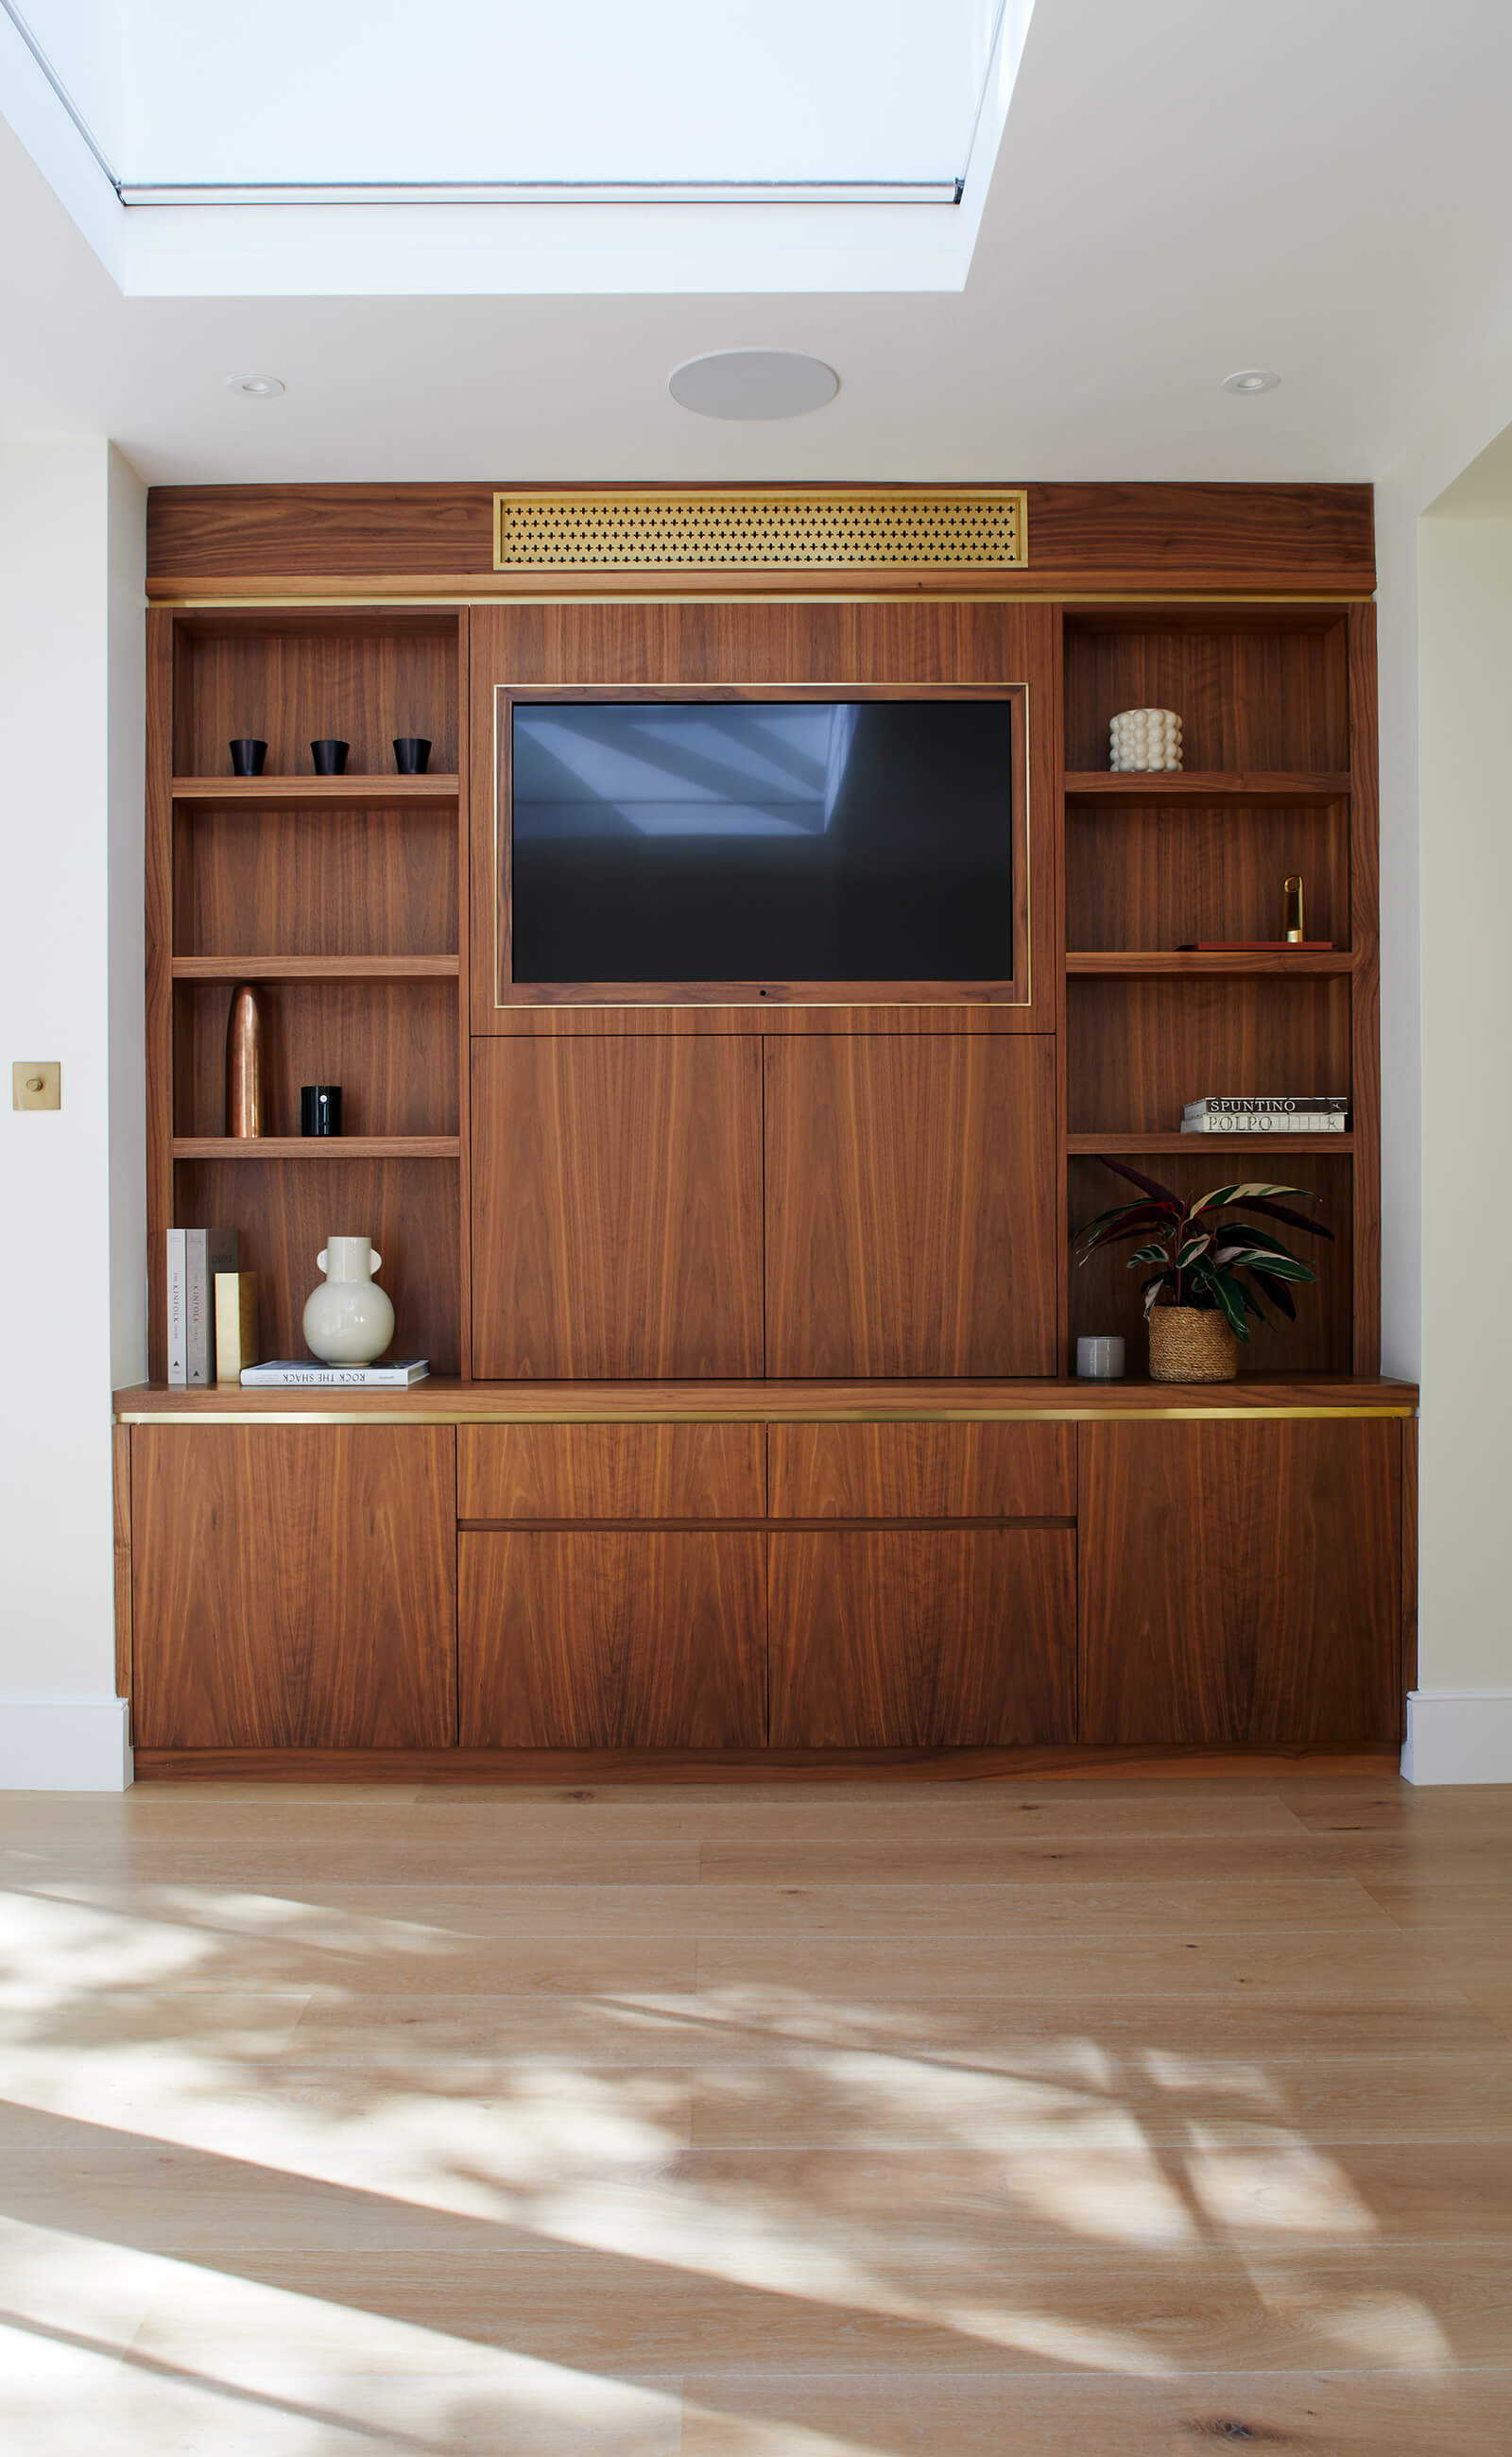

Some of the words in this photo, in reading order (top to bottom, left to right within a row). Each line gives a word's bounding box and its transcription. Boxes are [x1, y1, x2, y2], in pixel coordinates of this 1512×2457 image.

[1210, 1100, 1296, 1112] SPUNTINO
[1209, 1116, 1272, 1131] POLPO
[282, 1373, 314, 1383] SHACK
[318, 1373, 335, 1383] THE
[339, 1373, 366, 1383] ROCK
